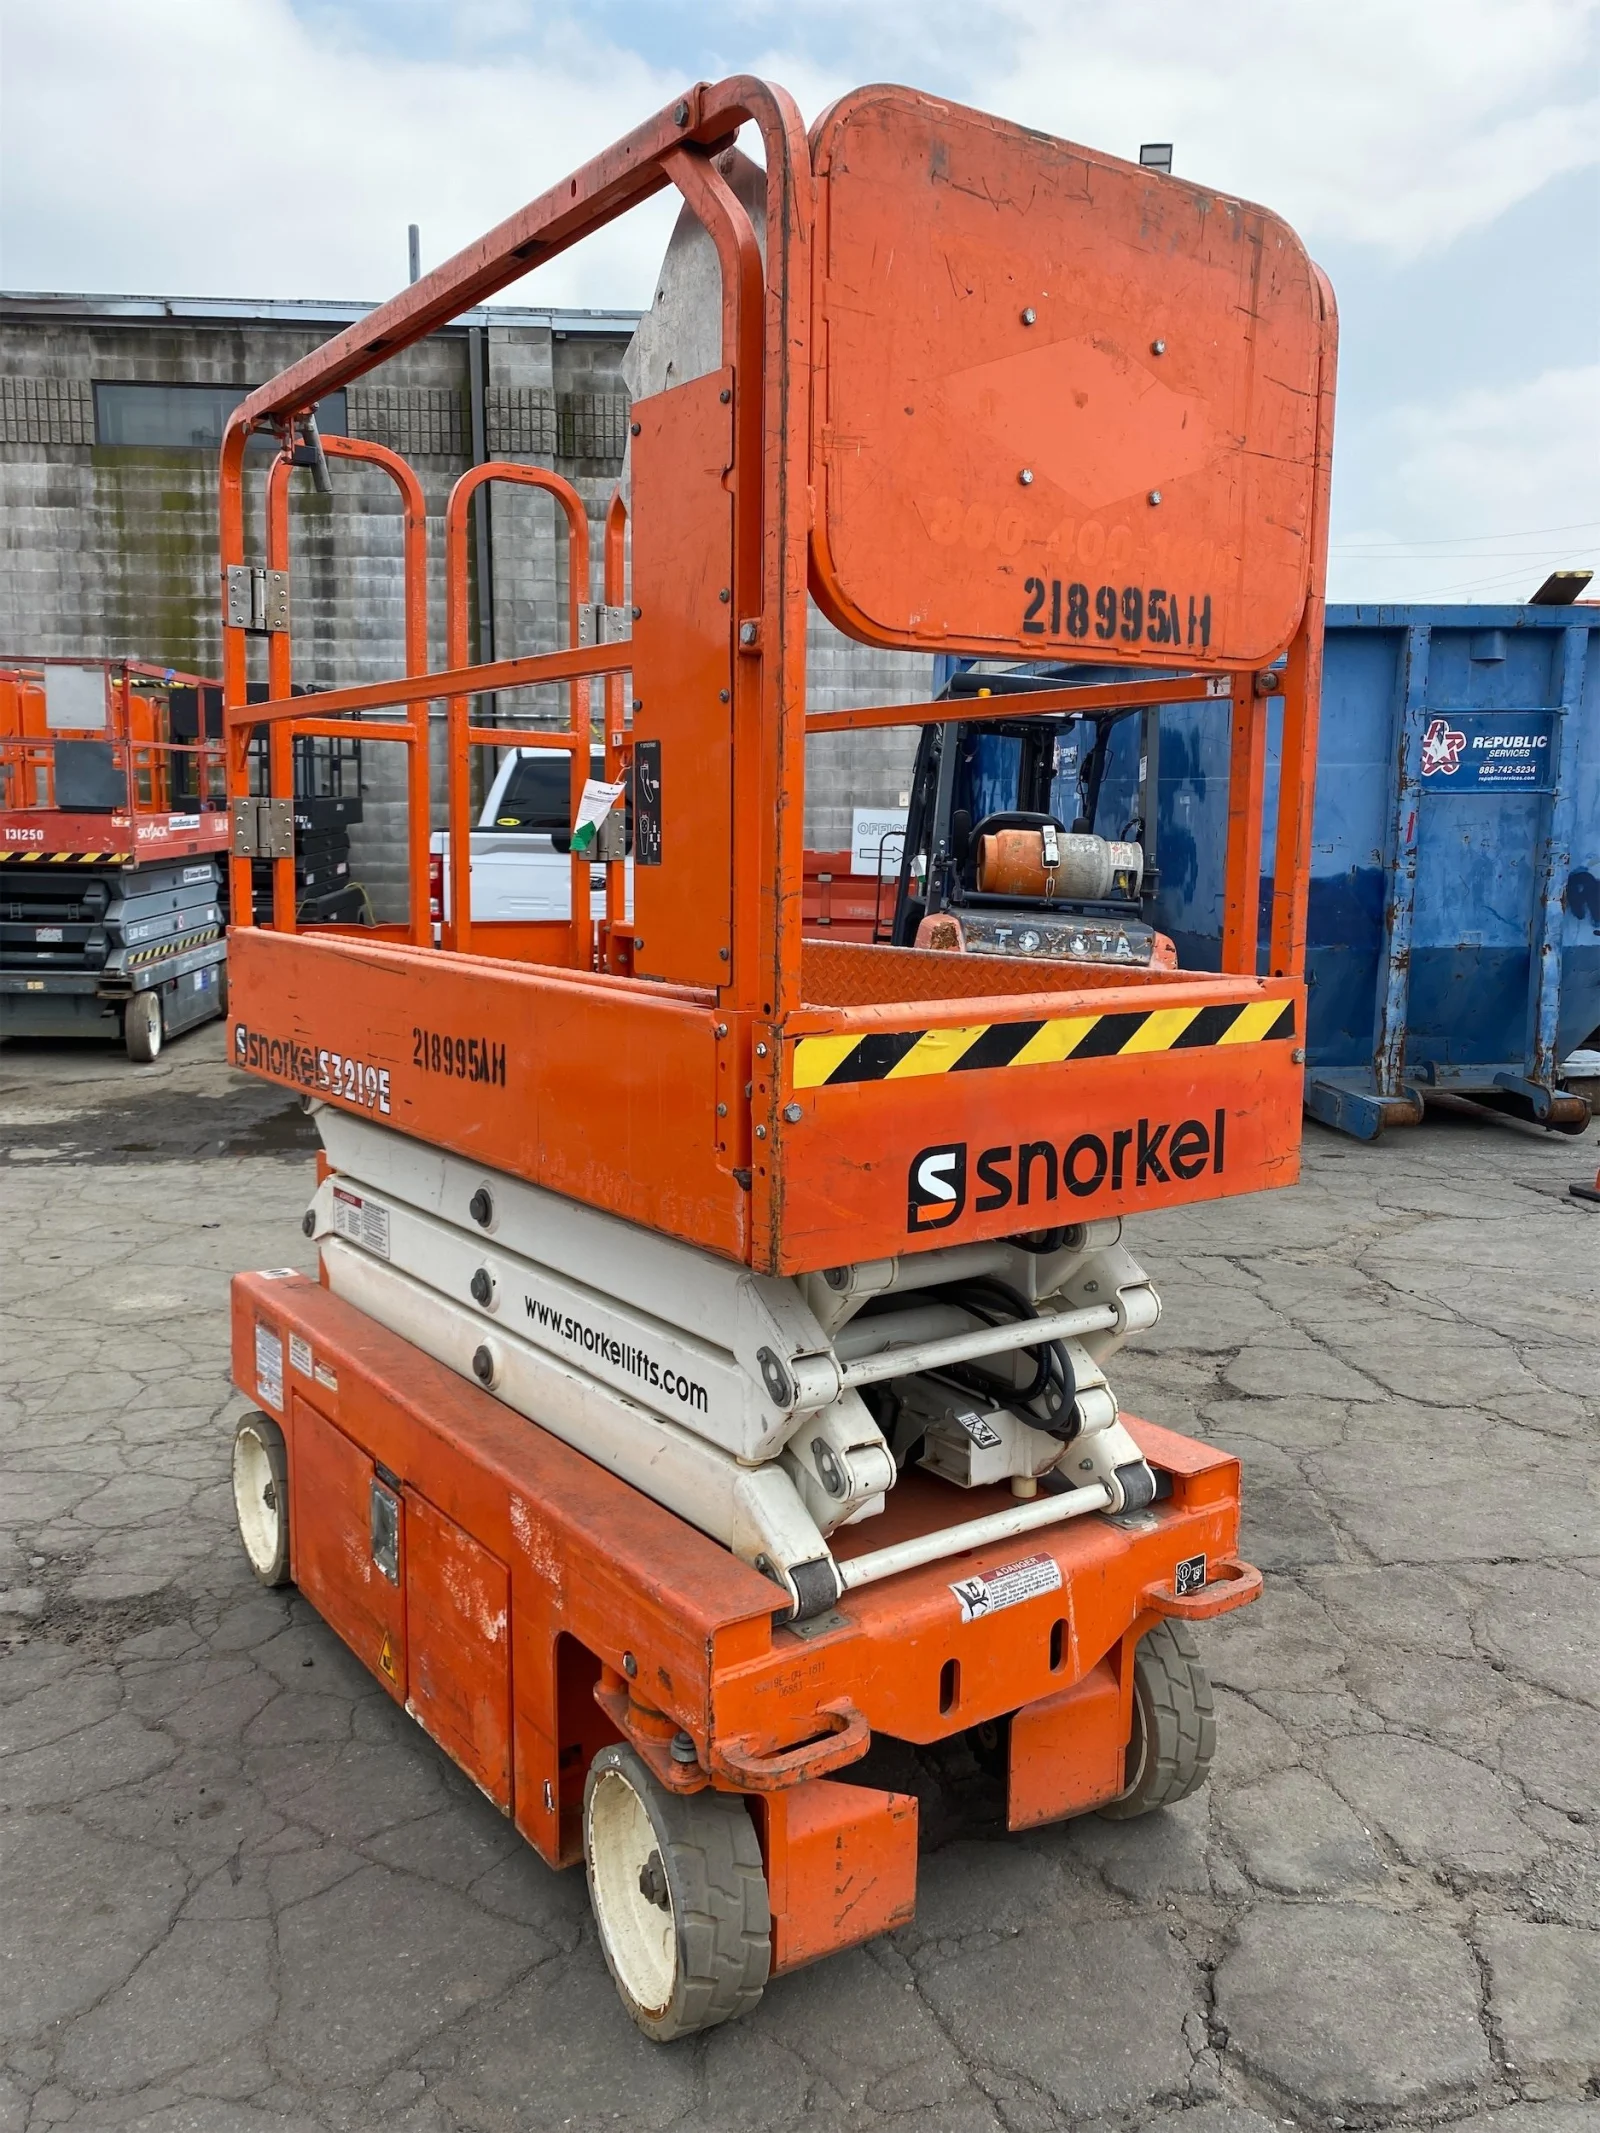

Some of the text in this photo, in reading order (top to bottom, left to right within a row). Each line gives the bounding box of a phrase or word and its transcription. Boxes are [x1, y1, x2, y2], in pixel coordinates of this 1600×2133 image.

[1023, 577, 1211, 647] 218995AH
[1472, 736, 1547, 748] REPUBLIC
[1488, 749, 1531, 758] SERVICES
[1478, 765, 1536, 774] 888-742-5234
[5, 828, 44, 840] 131250
[857, 822, 907, 835] OFFIC
[248, 1033, 320, 1089] snorkel
[412, 1027, 506, 1087] 218995AH
[975, 1108, 1225, 1212] snorkel
[525, 1296, 708, 1413] www.snorkellifts.com
[1000, 1557, 1040, 1575] DANGER
